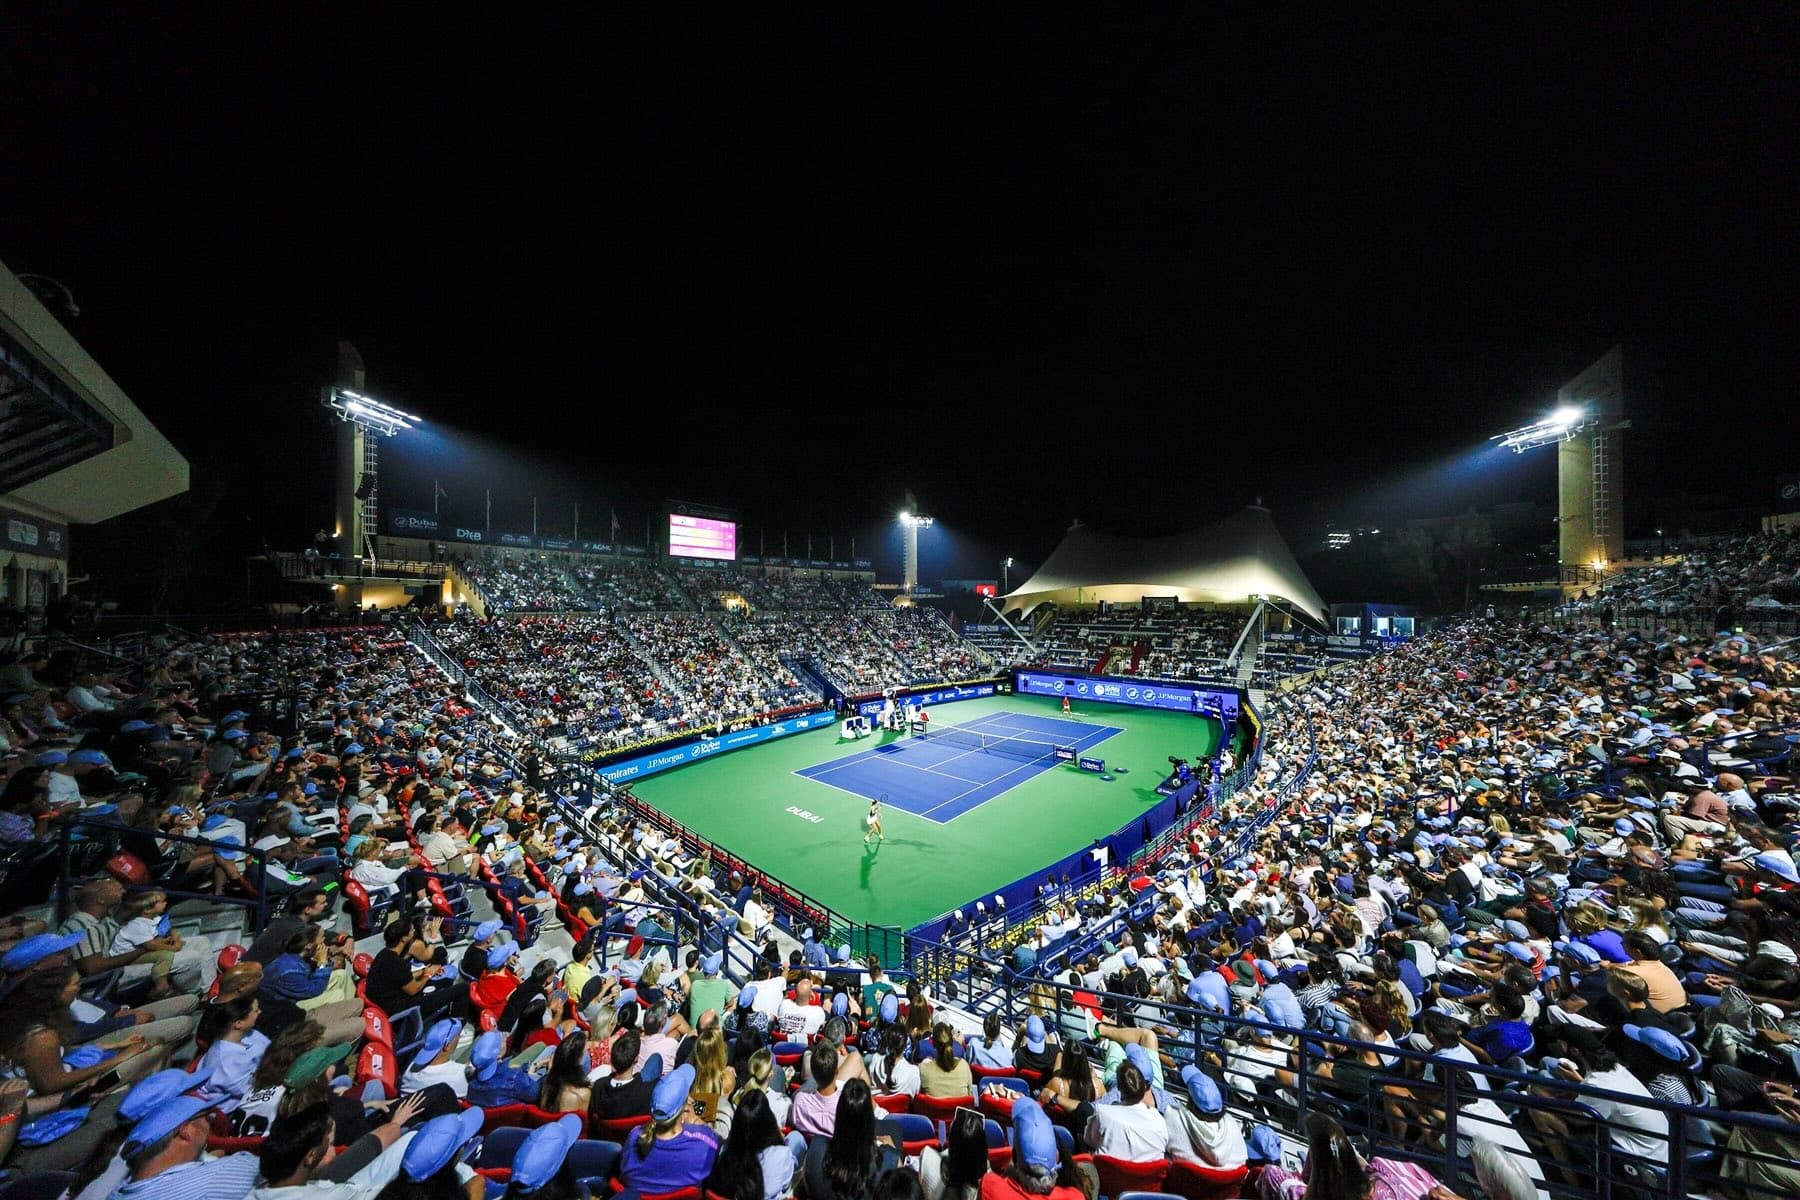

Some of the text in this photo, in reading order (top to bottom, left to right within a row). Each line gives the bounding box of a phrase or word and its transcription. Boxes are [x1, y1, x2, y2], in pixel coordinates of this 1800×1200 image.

[1158, 692, 1191, 702] J.P.Morgan
[647, 753, 685, 768] J.P.Morgan
[784, 805, 825, 823] DUBAI
[784, 1014, 806, 1023] LACOSTE
